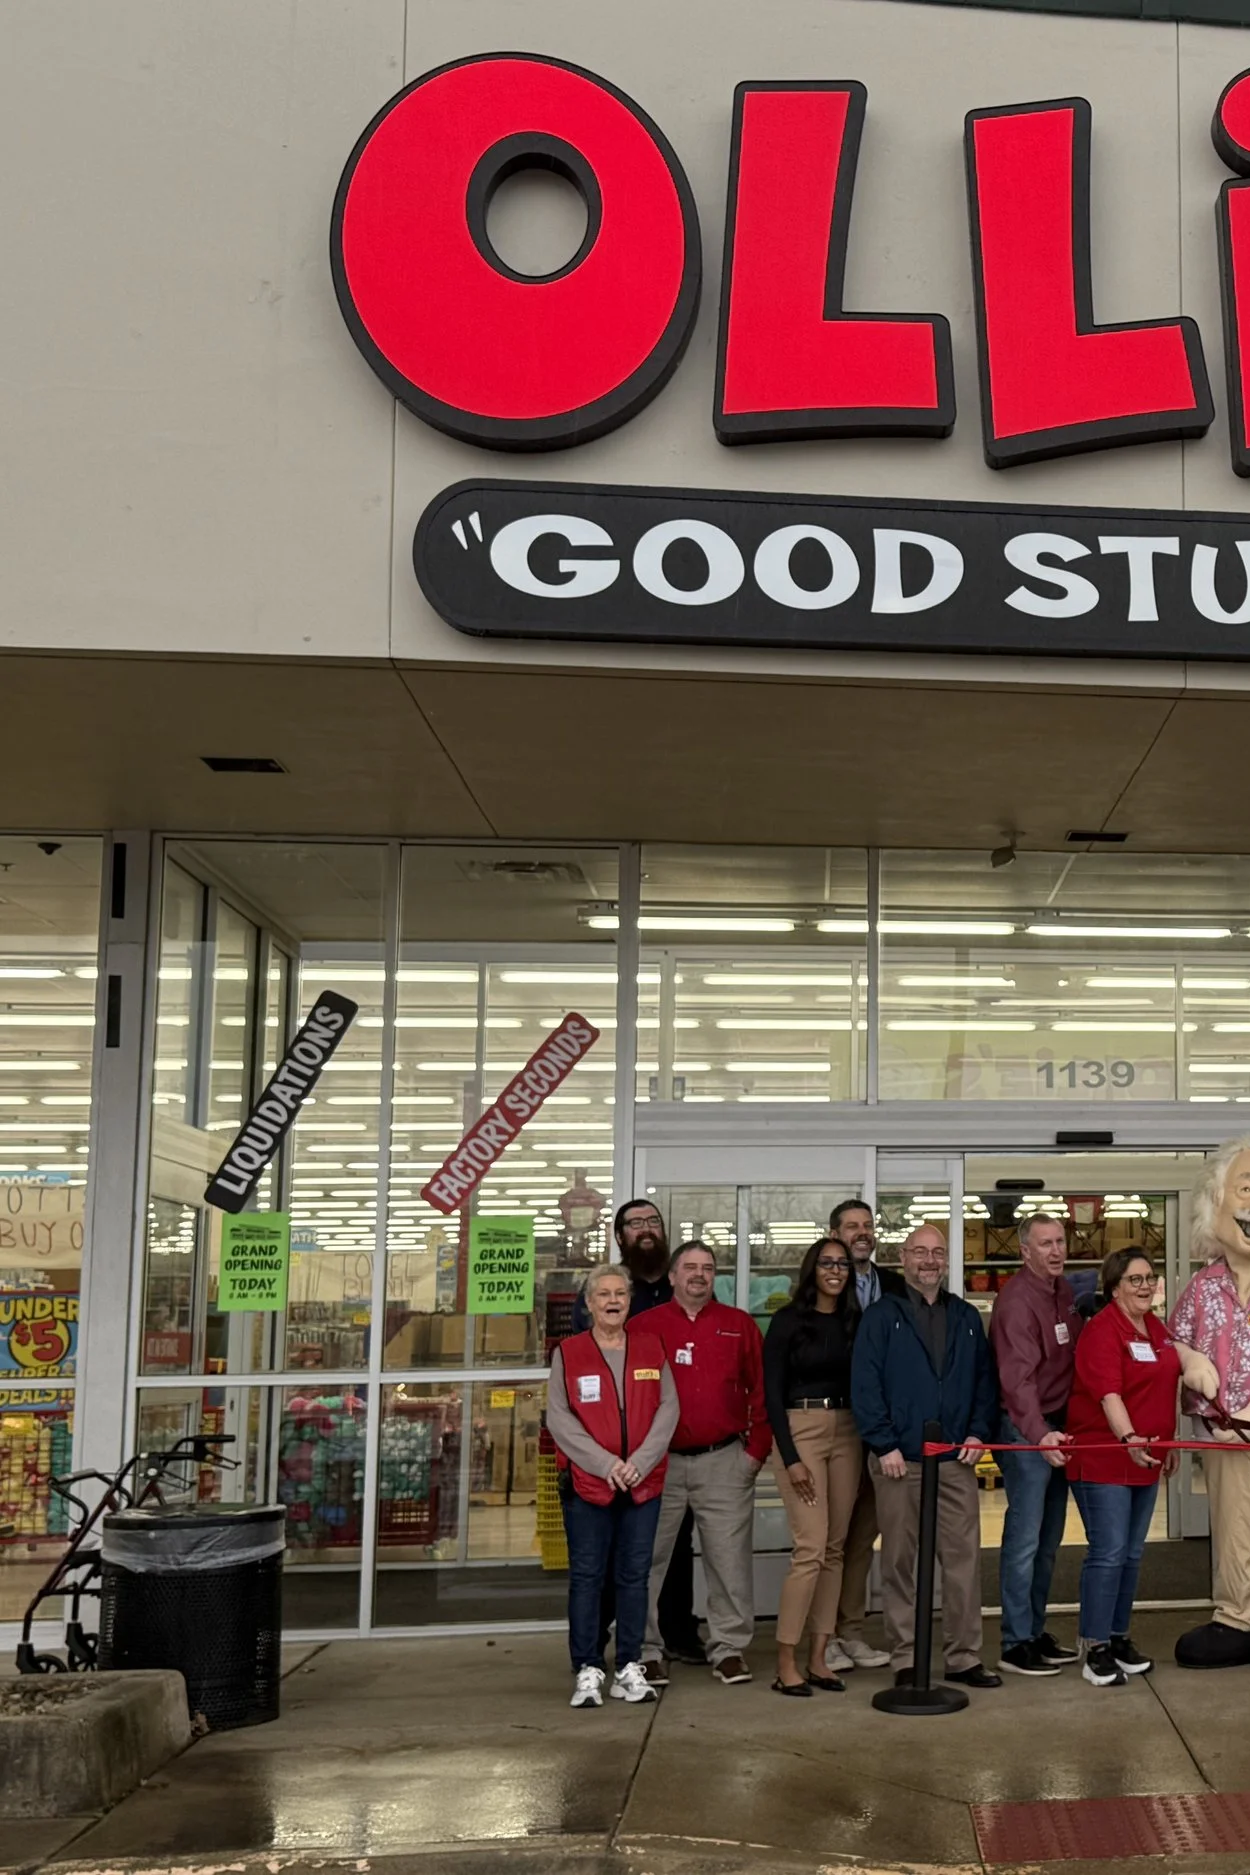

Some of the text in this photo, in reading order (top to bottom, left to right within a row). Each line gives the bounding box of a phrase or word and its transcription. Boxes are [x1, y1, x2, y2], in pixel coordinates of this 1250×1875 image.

[1036, 1060, 1135, 1089] 1139
[216, 1005, 345, 1196] LIQUIDATIONS
[430, 1020, 592, 1206] FACTORY SECONDS
[231, 1244, 279, 1257] GRAND
[479, 1248, 525, 1261] GRAND
[224, 1259, 283, 1272] OPENING
[474, 1262, 530, 1275] OPENING
[229, 1278, 277, 1291] TODAY
[478, 1281, 524, 1294] TODAY
[0, 1296, 79, 1325] UNDER
[14, 1319, 65, 1362] $5
